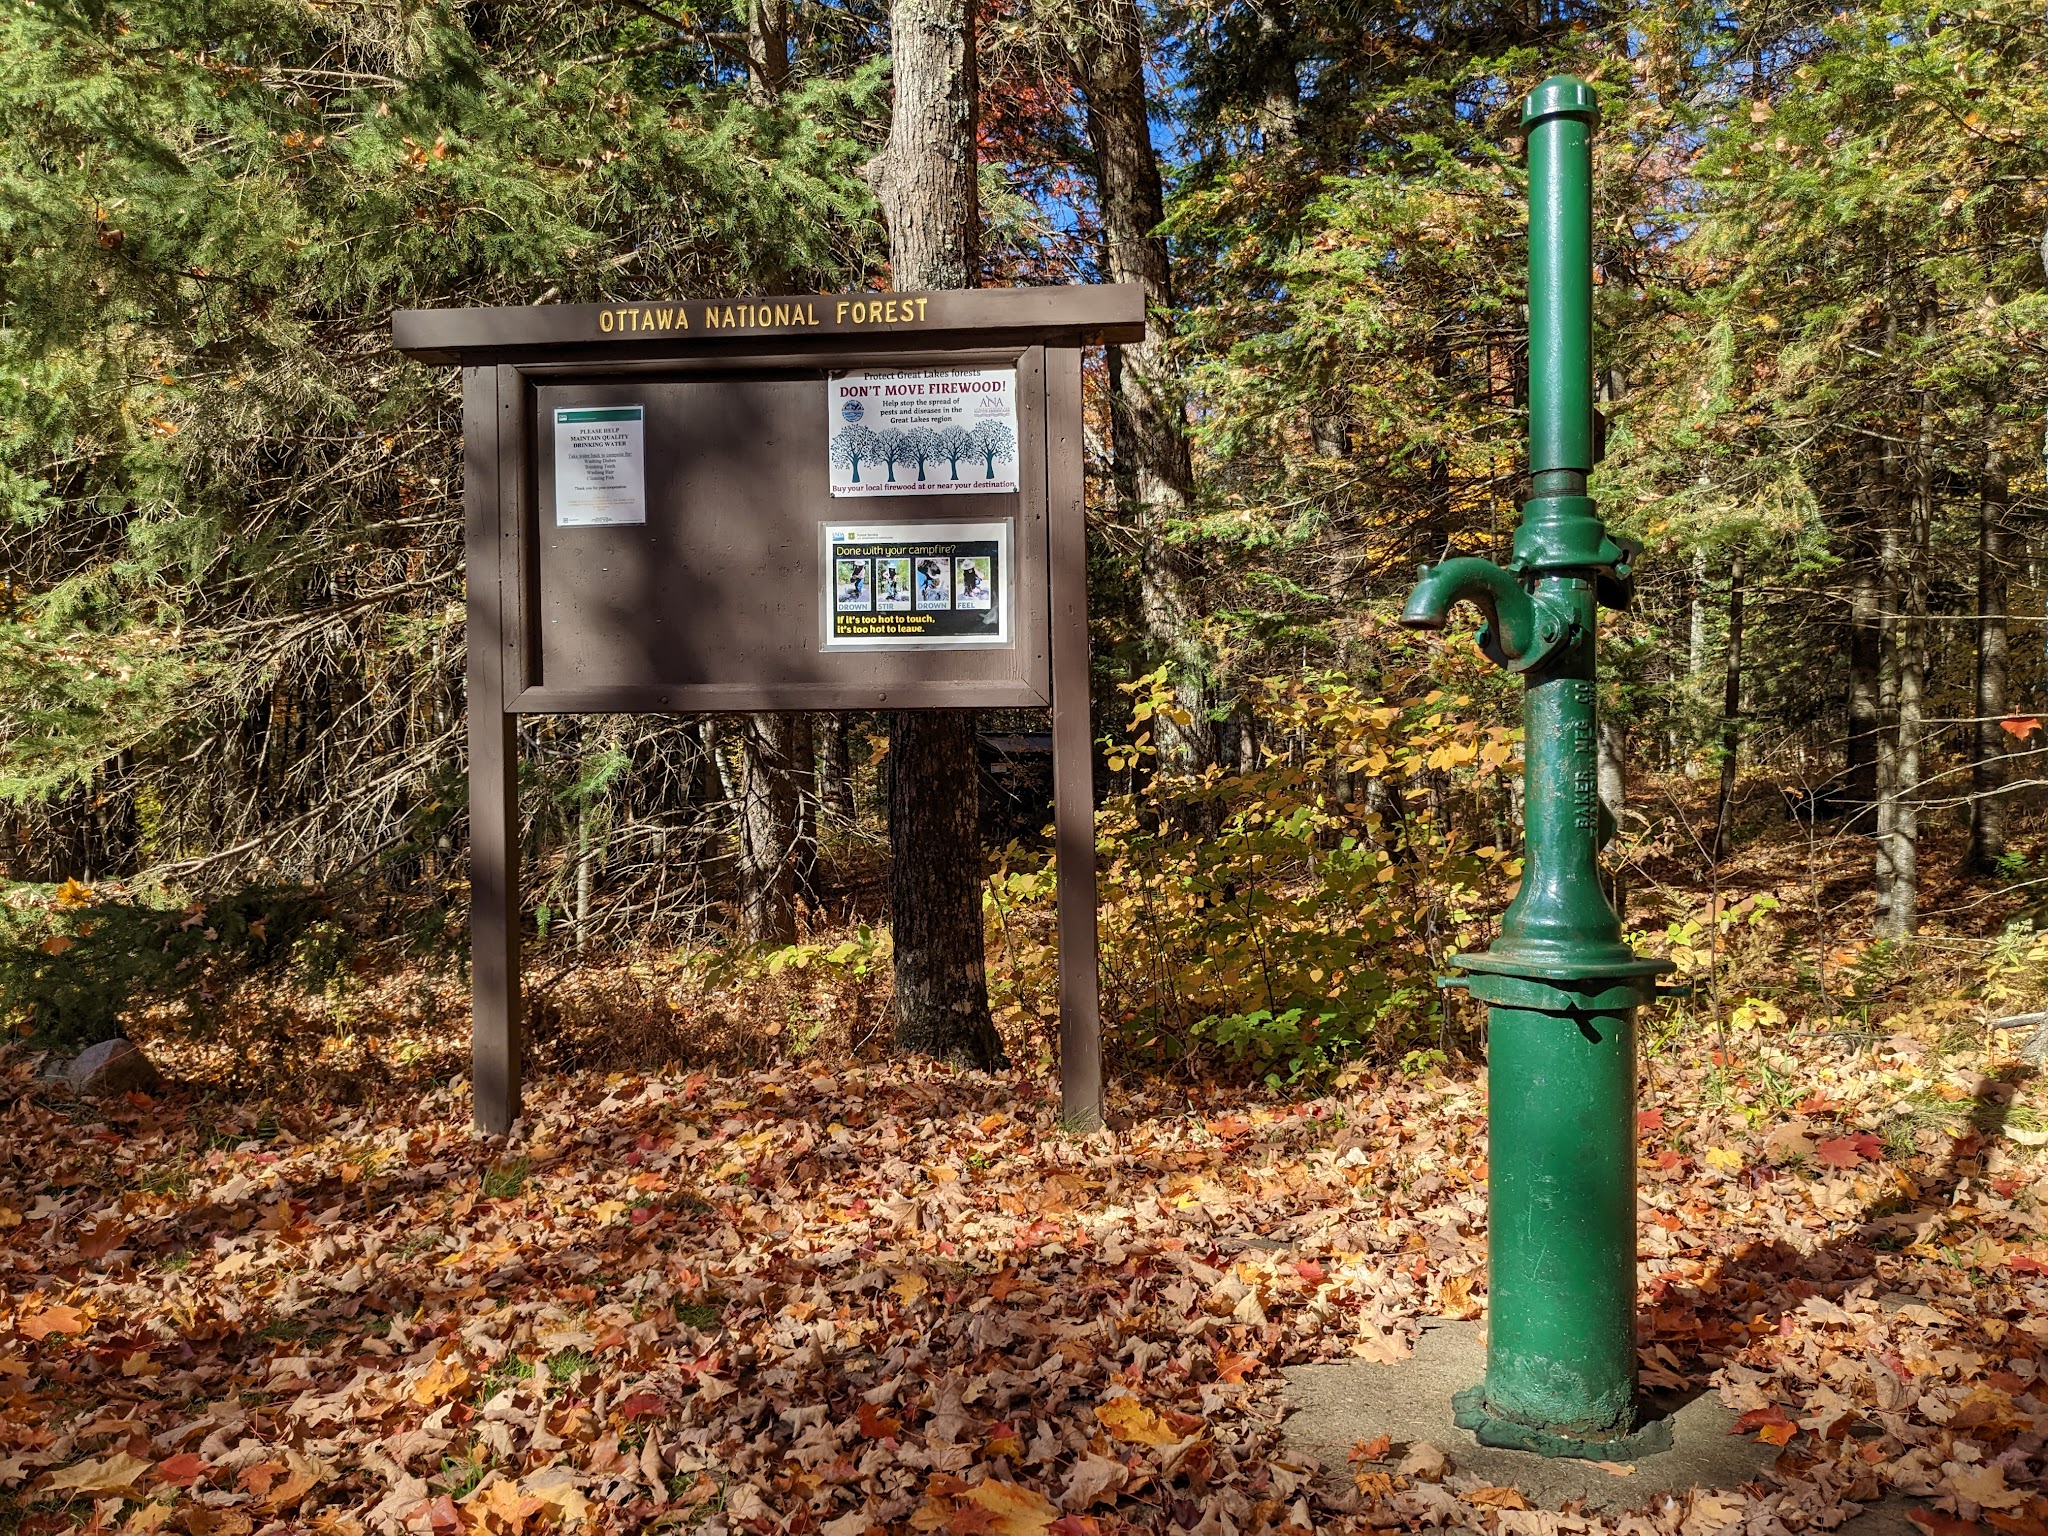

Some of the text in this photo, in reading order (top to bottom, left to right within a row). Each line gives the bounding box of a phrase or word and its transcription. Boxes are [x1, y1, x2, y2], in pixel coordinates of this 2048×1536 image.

[600, 297, 928, 333] OTTAWA NATIONAL FOREST
[864, 369, 981, 381] Protect Great Lakes forests
[839, 380, 1007, 398] DON'T MOVE FIREWOOD!
[882, 397, 961, 408] Help stop the spread of
[980, 395, 1004, 408] ANA
[880, 409, 898, 417] pests
[913, 407, 941, 415] diseases
[951, 406, 963, 414] the
[931, 415, 953, 424] region
[832, 485, 846, 494] Buy
[847, 485, 864, 494] your
[866, 483, 883, 491] local
[884, 482, 916, 491] firewood
[954, 483, 971, 491] your
[836, 544, 956, 557] Done with your campfire?
[837, 614, 935, 624] If it's too hot to touch,
[837, 623, 925, 634] it's too hot to leave.
[1574, 770, 1590, 828] BAKER
